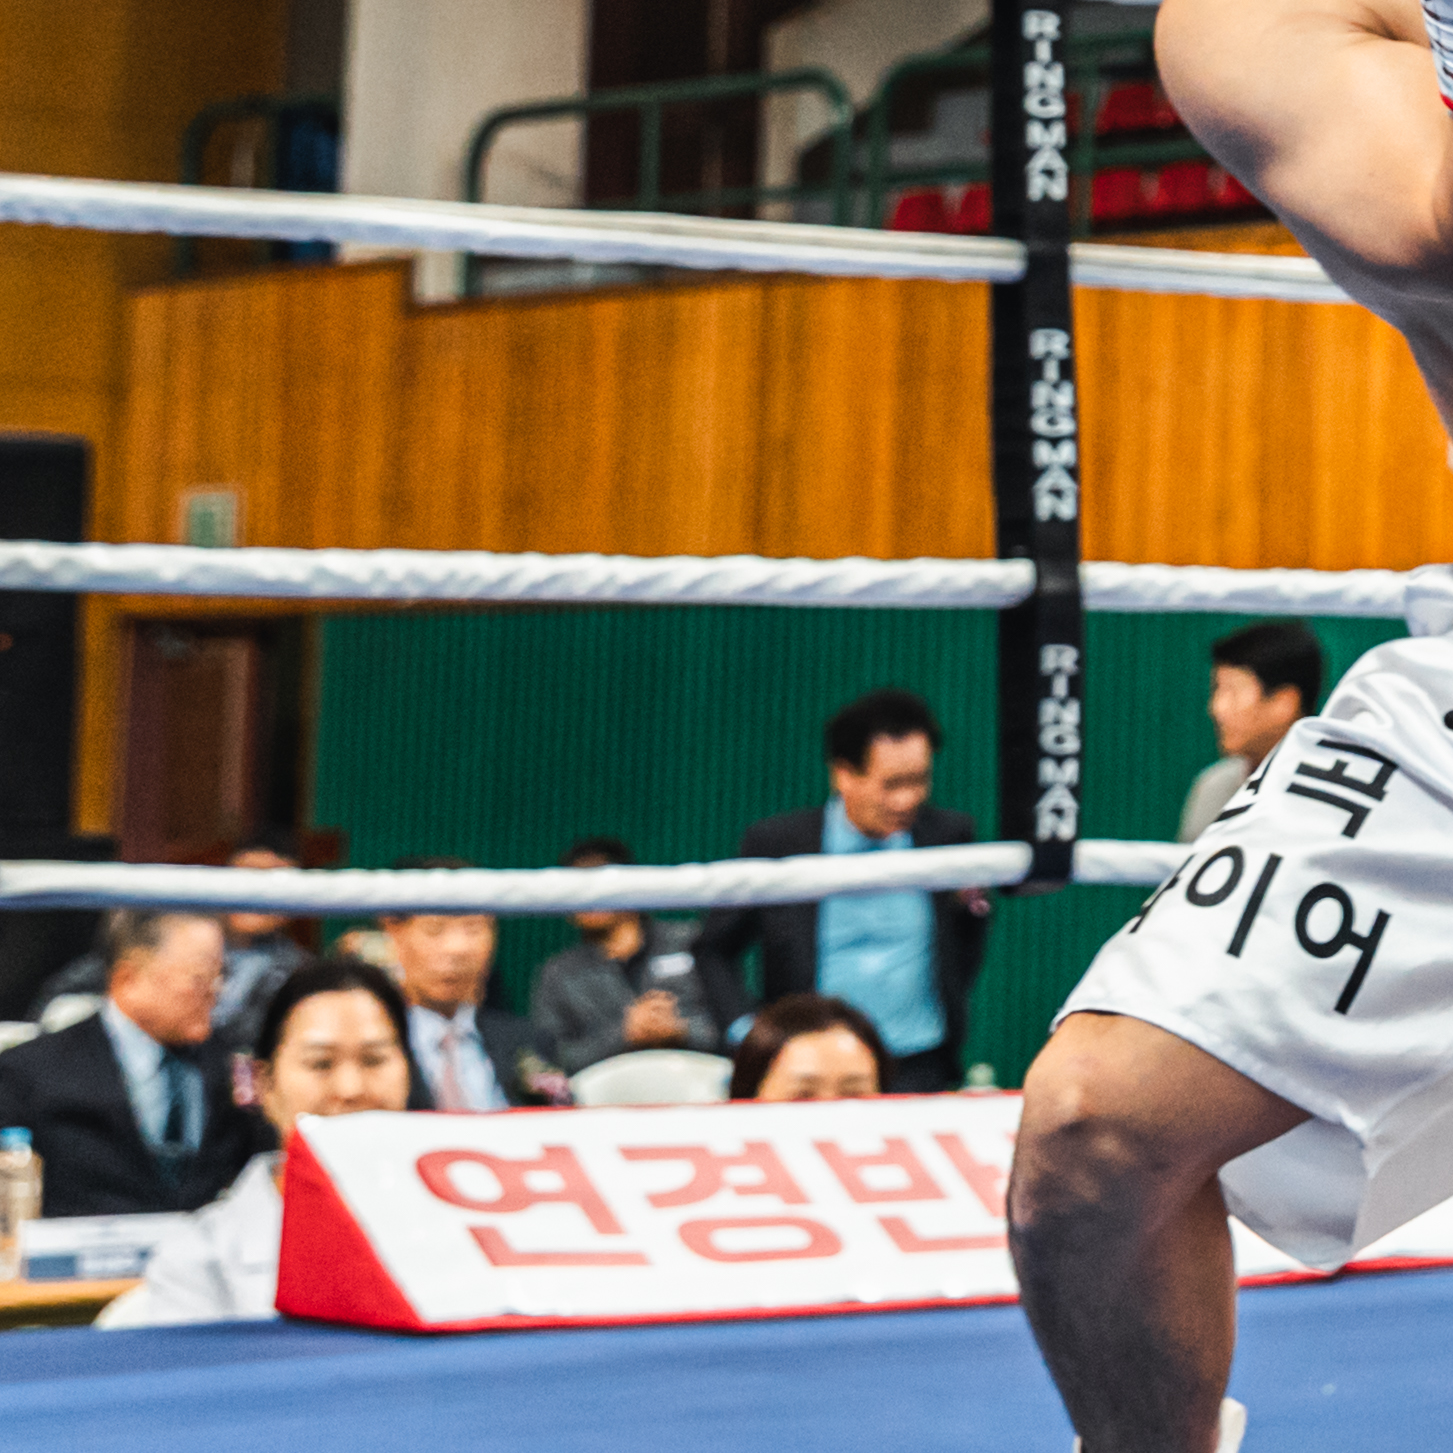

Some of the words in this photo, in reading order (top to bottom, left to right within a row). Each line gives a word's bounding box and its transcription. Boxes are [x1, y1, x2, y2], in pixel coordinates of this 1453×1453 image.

[1022, 8, 1069, 202] RINGMAN
[1028, 326, 1078, 524] RINGMAN
[1036, 642, 1083, 844] RINGMAN
[414, 1131, 1012, 1266] 연경반
